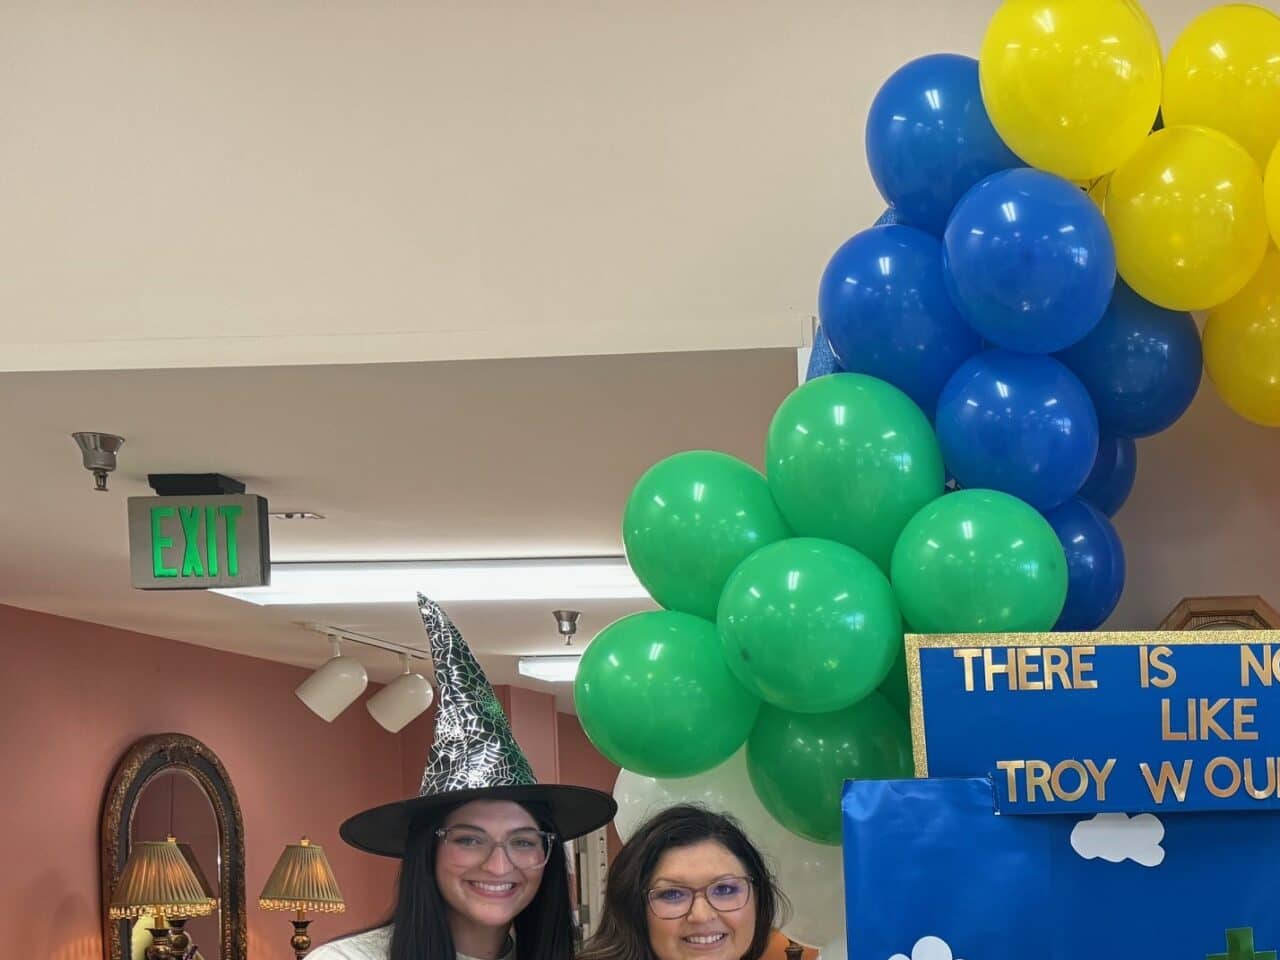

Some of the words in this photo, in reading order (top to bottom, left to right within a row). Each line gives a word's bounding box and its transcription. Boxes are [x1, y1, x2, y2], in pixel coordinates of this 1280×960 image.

[151, 504, 243, 578] EXIT
[953, 646, 1098, 691] THERE
[1139, 645, 1177, 689] IS
[1161, 698, 1259, 740] LIKE
[996, 758, 1117, 803] TROY
